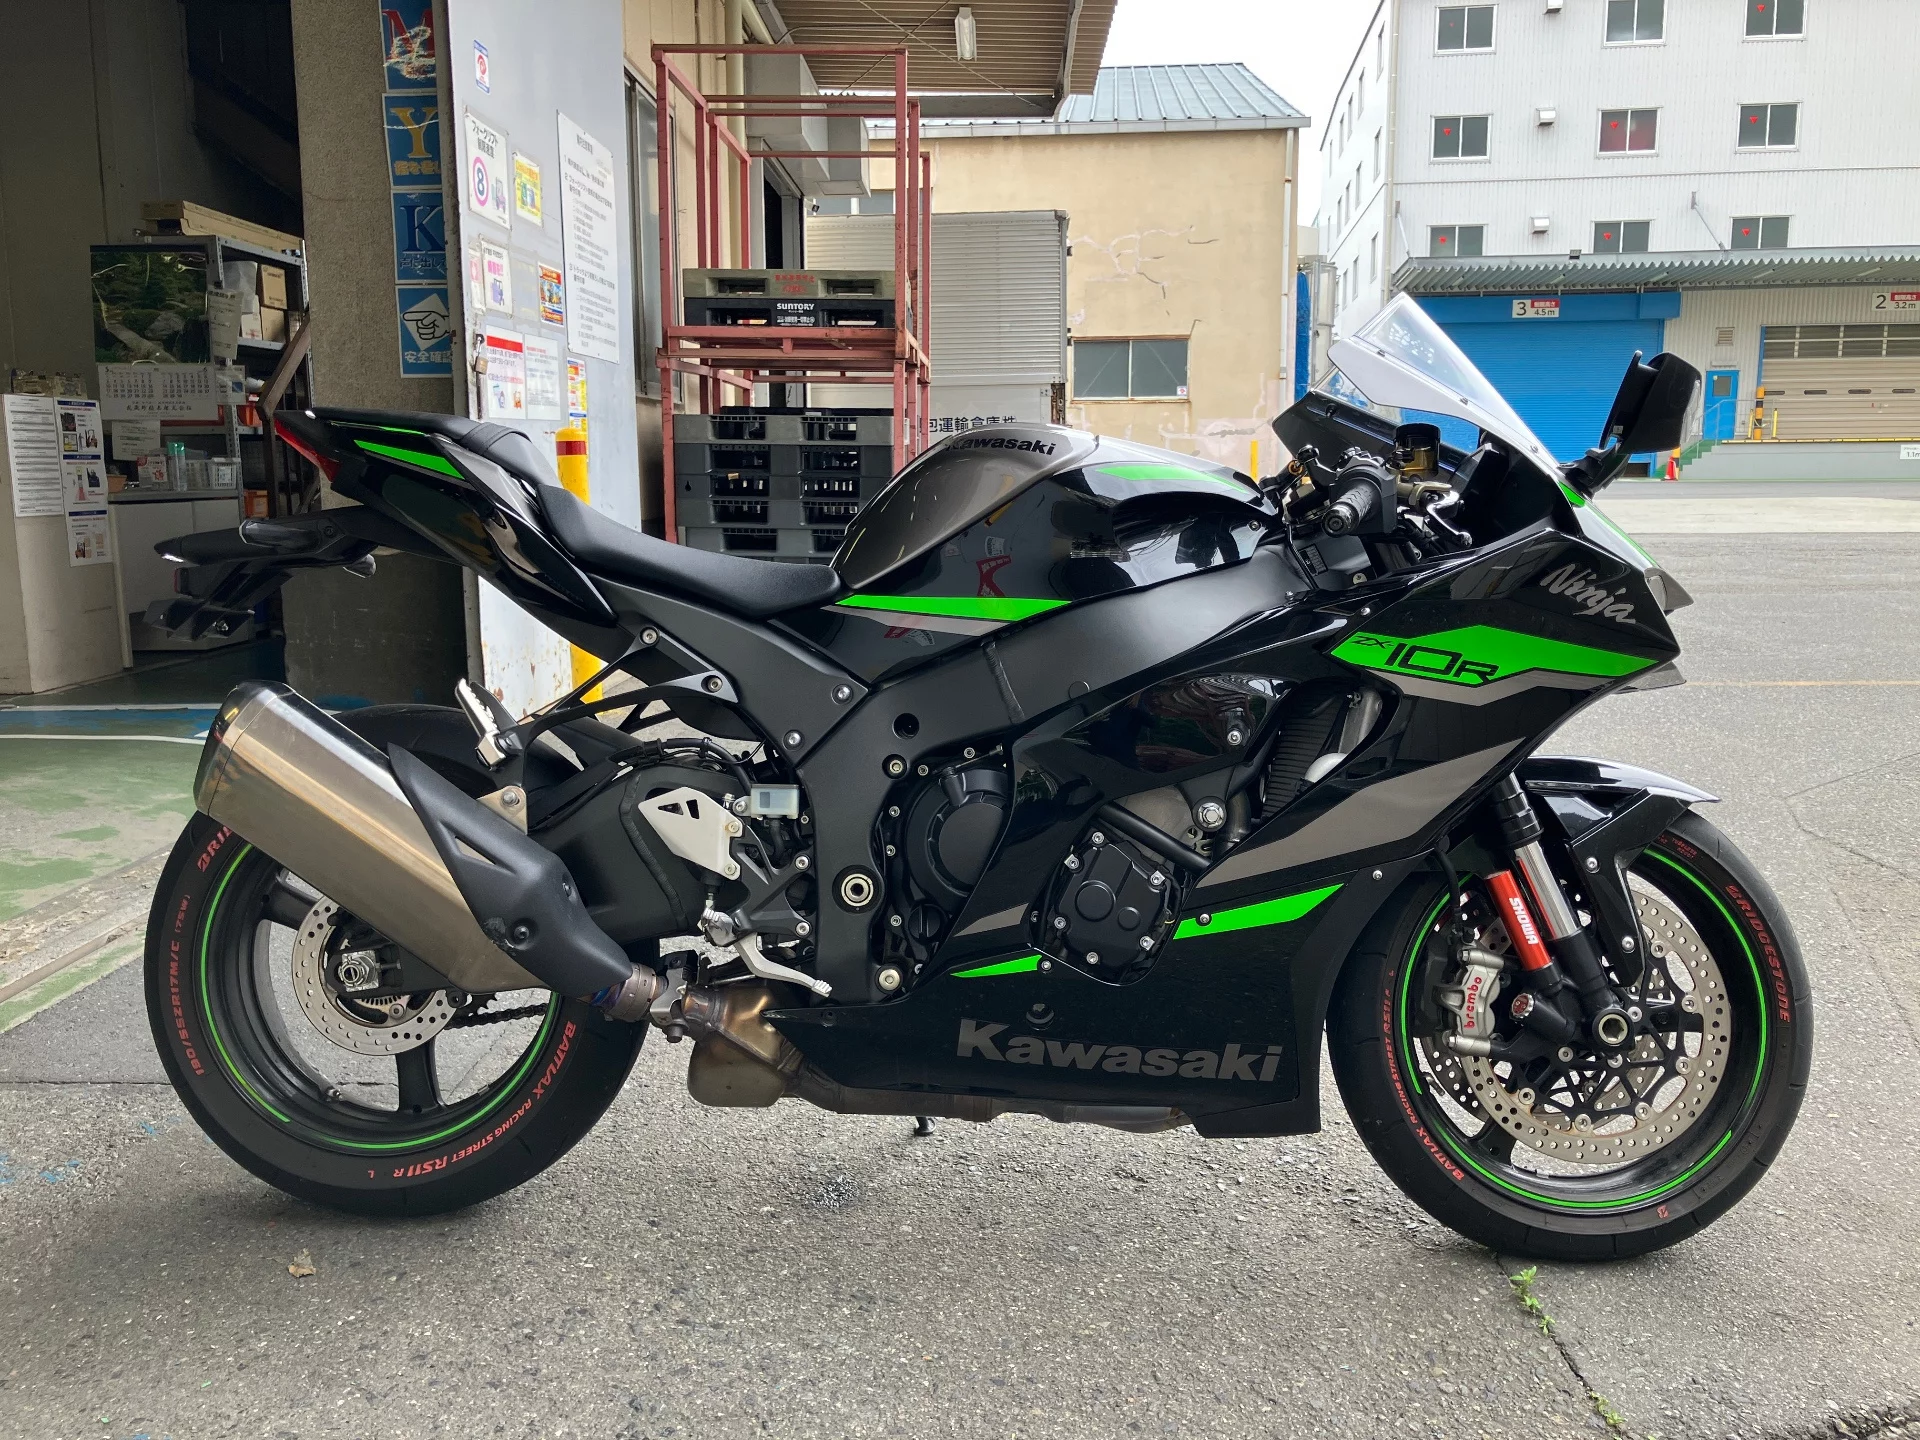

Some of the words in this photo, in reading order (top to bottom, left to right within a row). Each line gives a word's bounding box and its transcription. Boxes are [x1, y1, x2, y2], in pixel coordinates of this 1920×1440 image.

[391, 107, 439, 158] Y
[476, 166, 485, 197] 8
[400, 204, 446, 254] K
[1516, 301, 1527, 316] 3
[1875, 294, 1887, 309] 2
[945, 436, 1057, 456] Kawasaki
[1539, 563, 1636, 625] Ninja
[1508, 897, 1539, 945] SHOWA
[1463, 976, 1482, 1029] brembo
[956, 1018, 1283, 1082] Kawasaki
[494, 1098, 533, 1138] RACING
[451, 1132, 494, 1164] STREET
